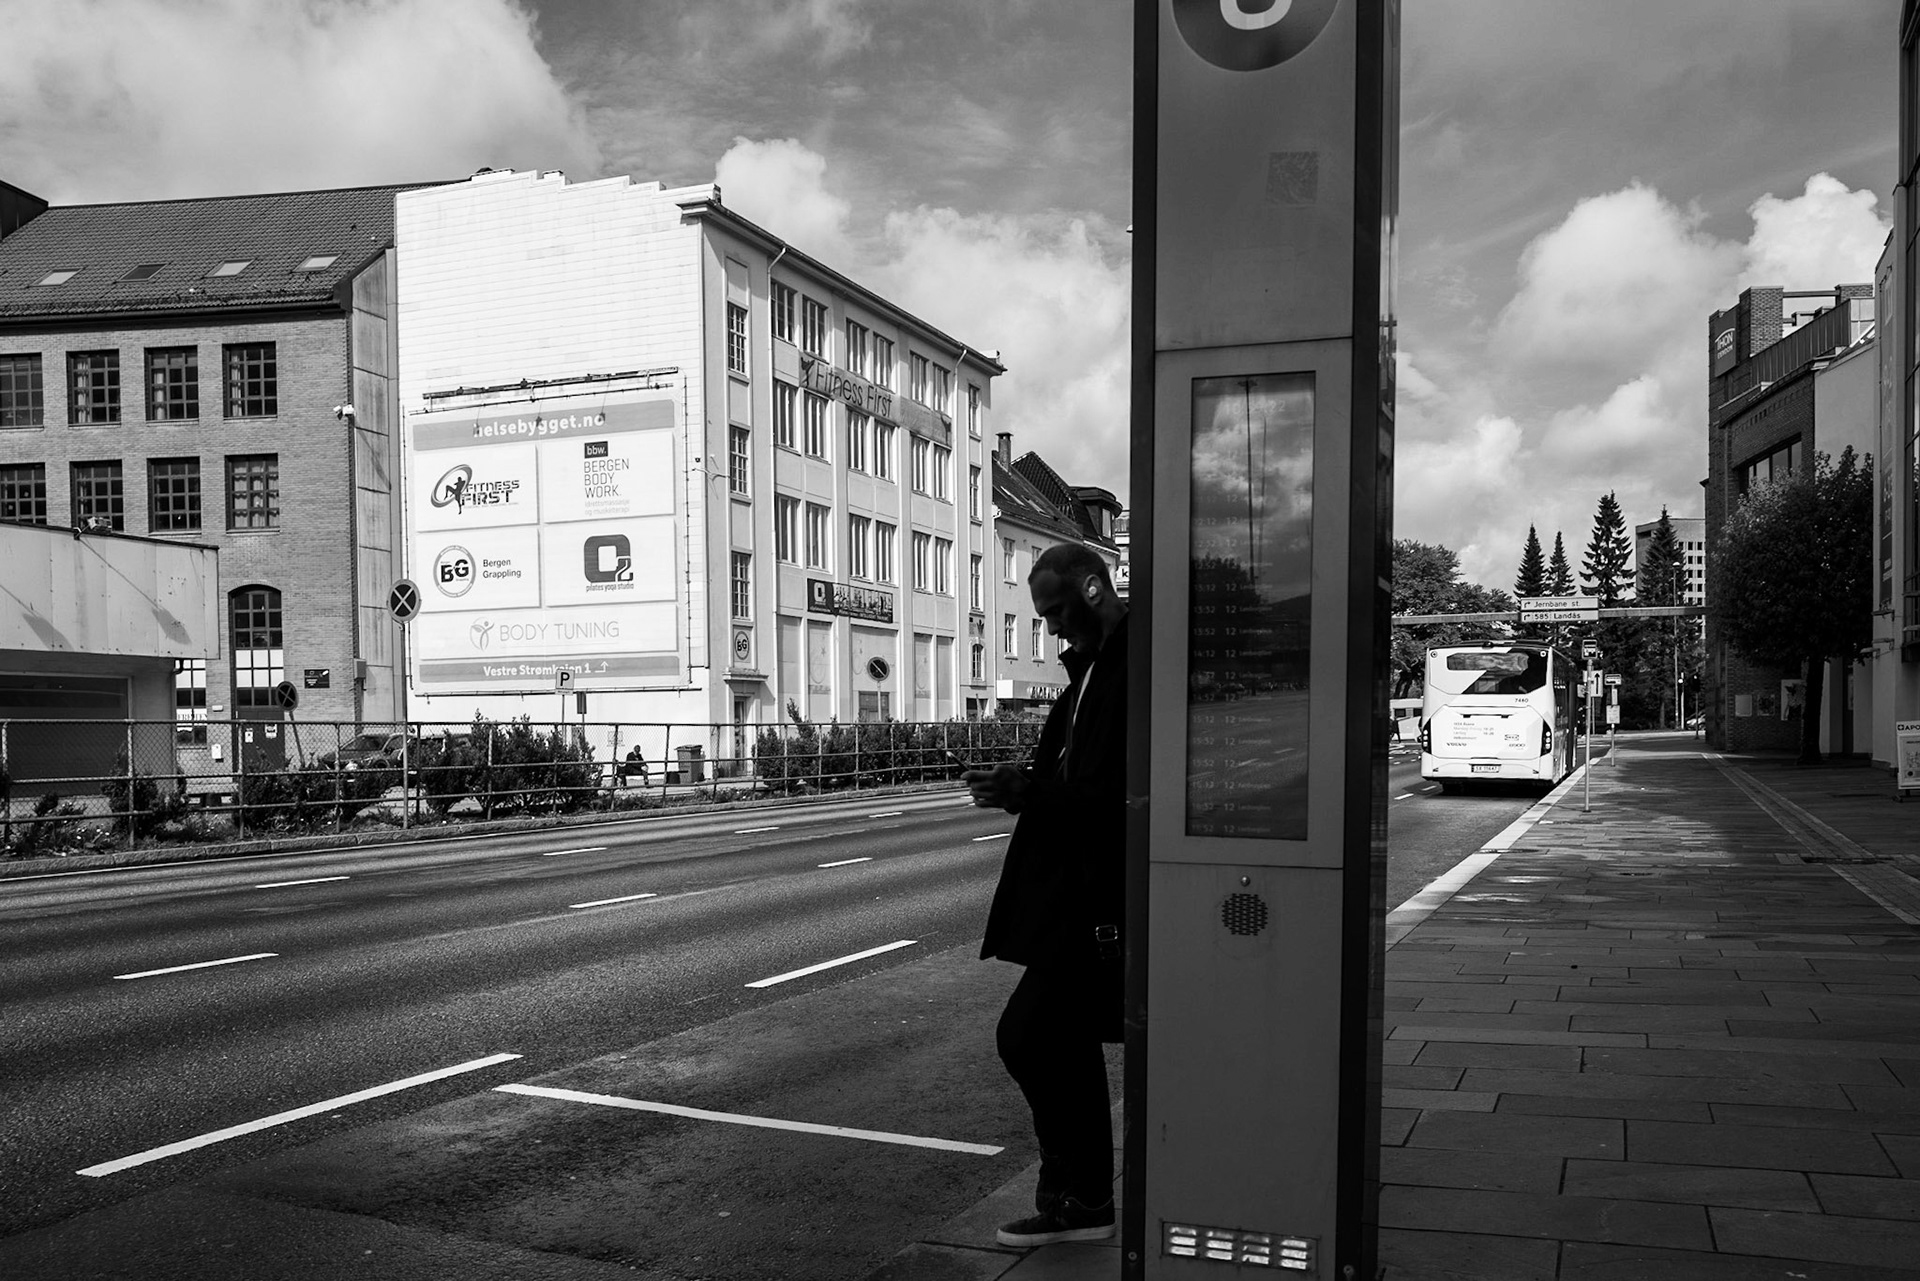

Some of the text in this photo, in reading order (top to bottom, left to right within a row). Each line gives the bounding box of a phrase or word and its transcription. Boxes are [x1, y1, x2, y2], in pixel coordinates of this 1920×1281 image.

[816, 362, 892, 418] Fitness First
[584, 458, 629, 473] BERGEN
[584, 472, 615, 486] BODY
[461, 490, 513, 505] FIRST
[440, 558, 470, 583] BG
[482, 558, 511, 568] Bergen
[482, 569, 522, 579] Grappling
[500, 621, 620, 642] BODY TUNING
[483, 665, 518, 676] Vestre
[584, 663, 592, 673] 1
[560, 671, 571, 687] P
